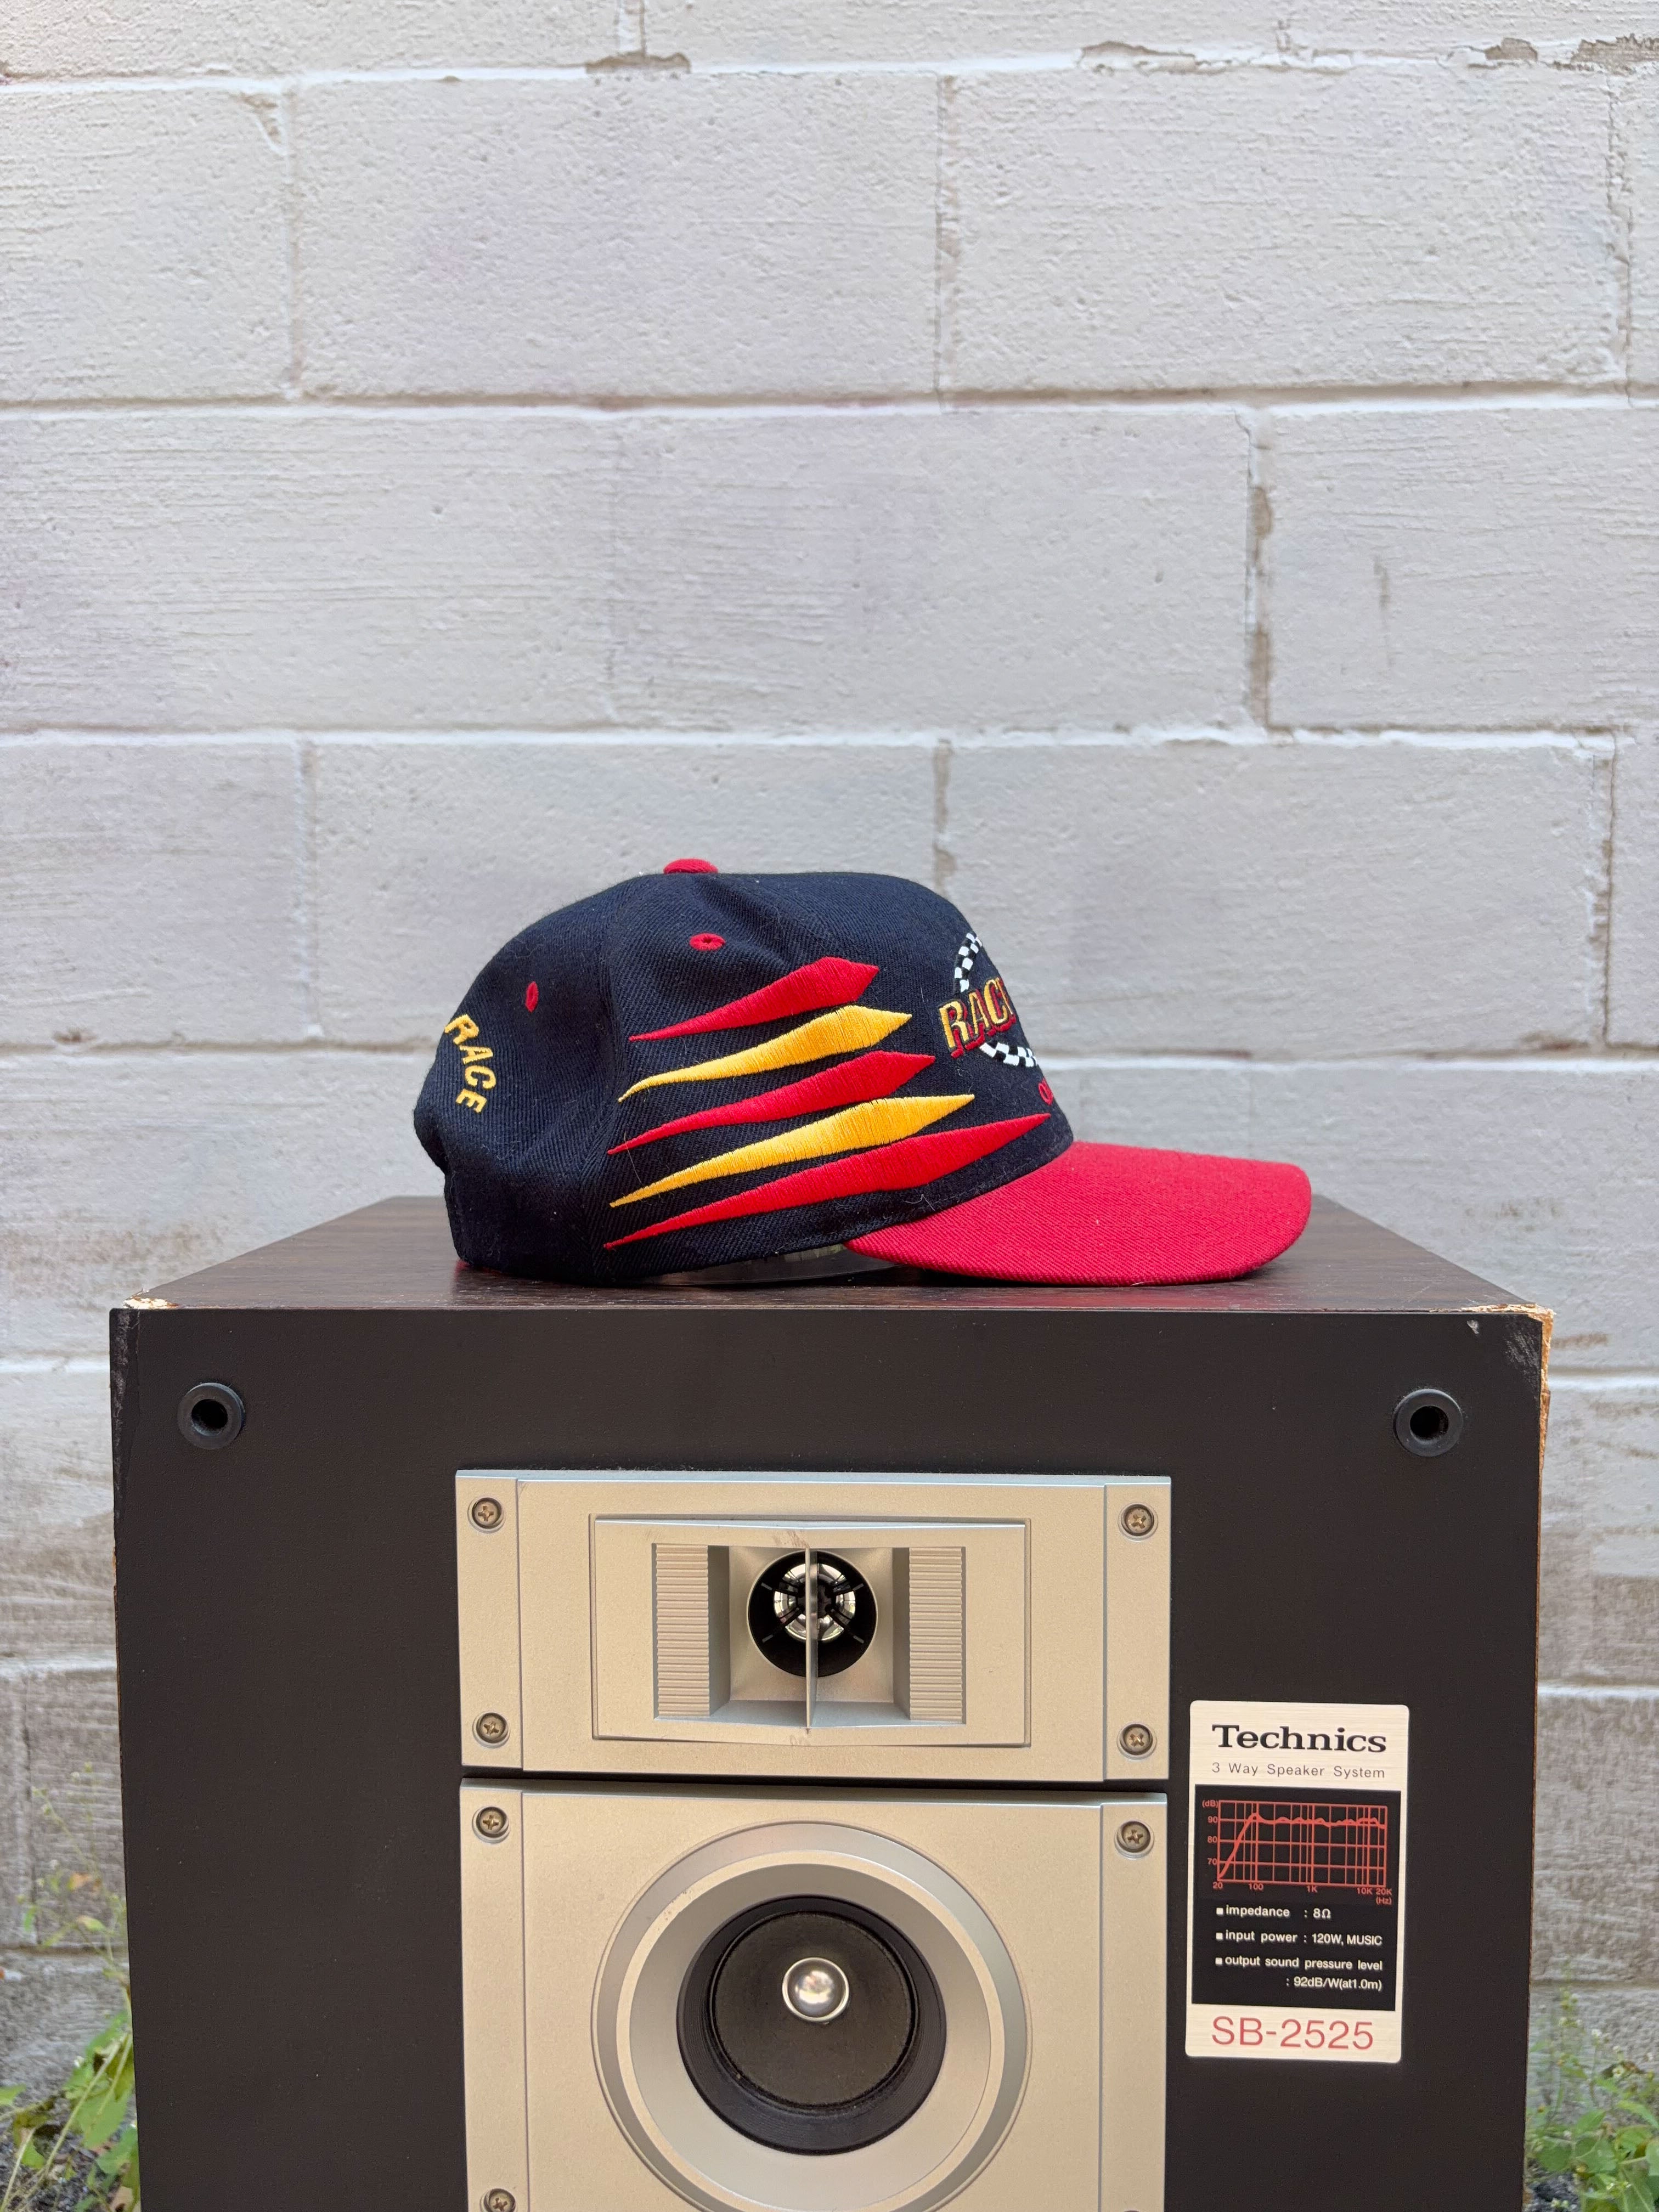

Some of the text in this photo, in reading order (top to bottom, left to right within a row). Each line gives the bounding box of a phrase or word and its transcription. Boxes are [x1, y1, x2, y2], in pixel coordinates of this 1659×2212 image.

[444, 1014, 496, 1113] RACE
[1212, 1724, 1386, 1752] Technics
[1212, 1762, 1385, 1779] 3 Way Speaker System
[1202, 1799, 1218, 1808] (dB)
[1376, 1896, 1392, 1905] (Hz)
[1226, 1905, 1290, 1918] impedance
[1226, 1929, 1255, 1942] input
[1261, 1933, 1297, 1943] power
[1312, 1934, 1344, 1945] 120W,
[1347, 1935, 1383, 1945] MUSIC
[1225, 1956, 1383, 1971] output sound pressure level
[1212, 2016, 1373, 2050] SB-2525
